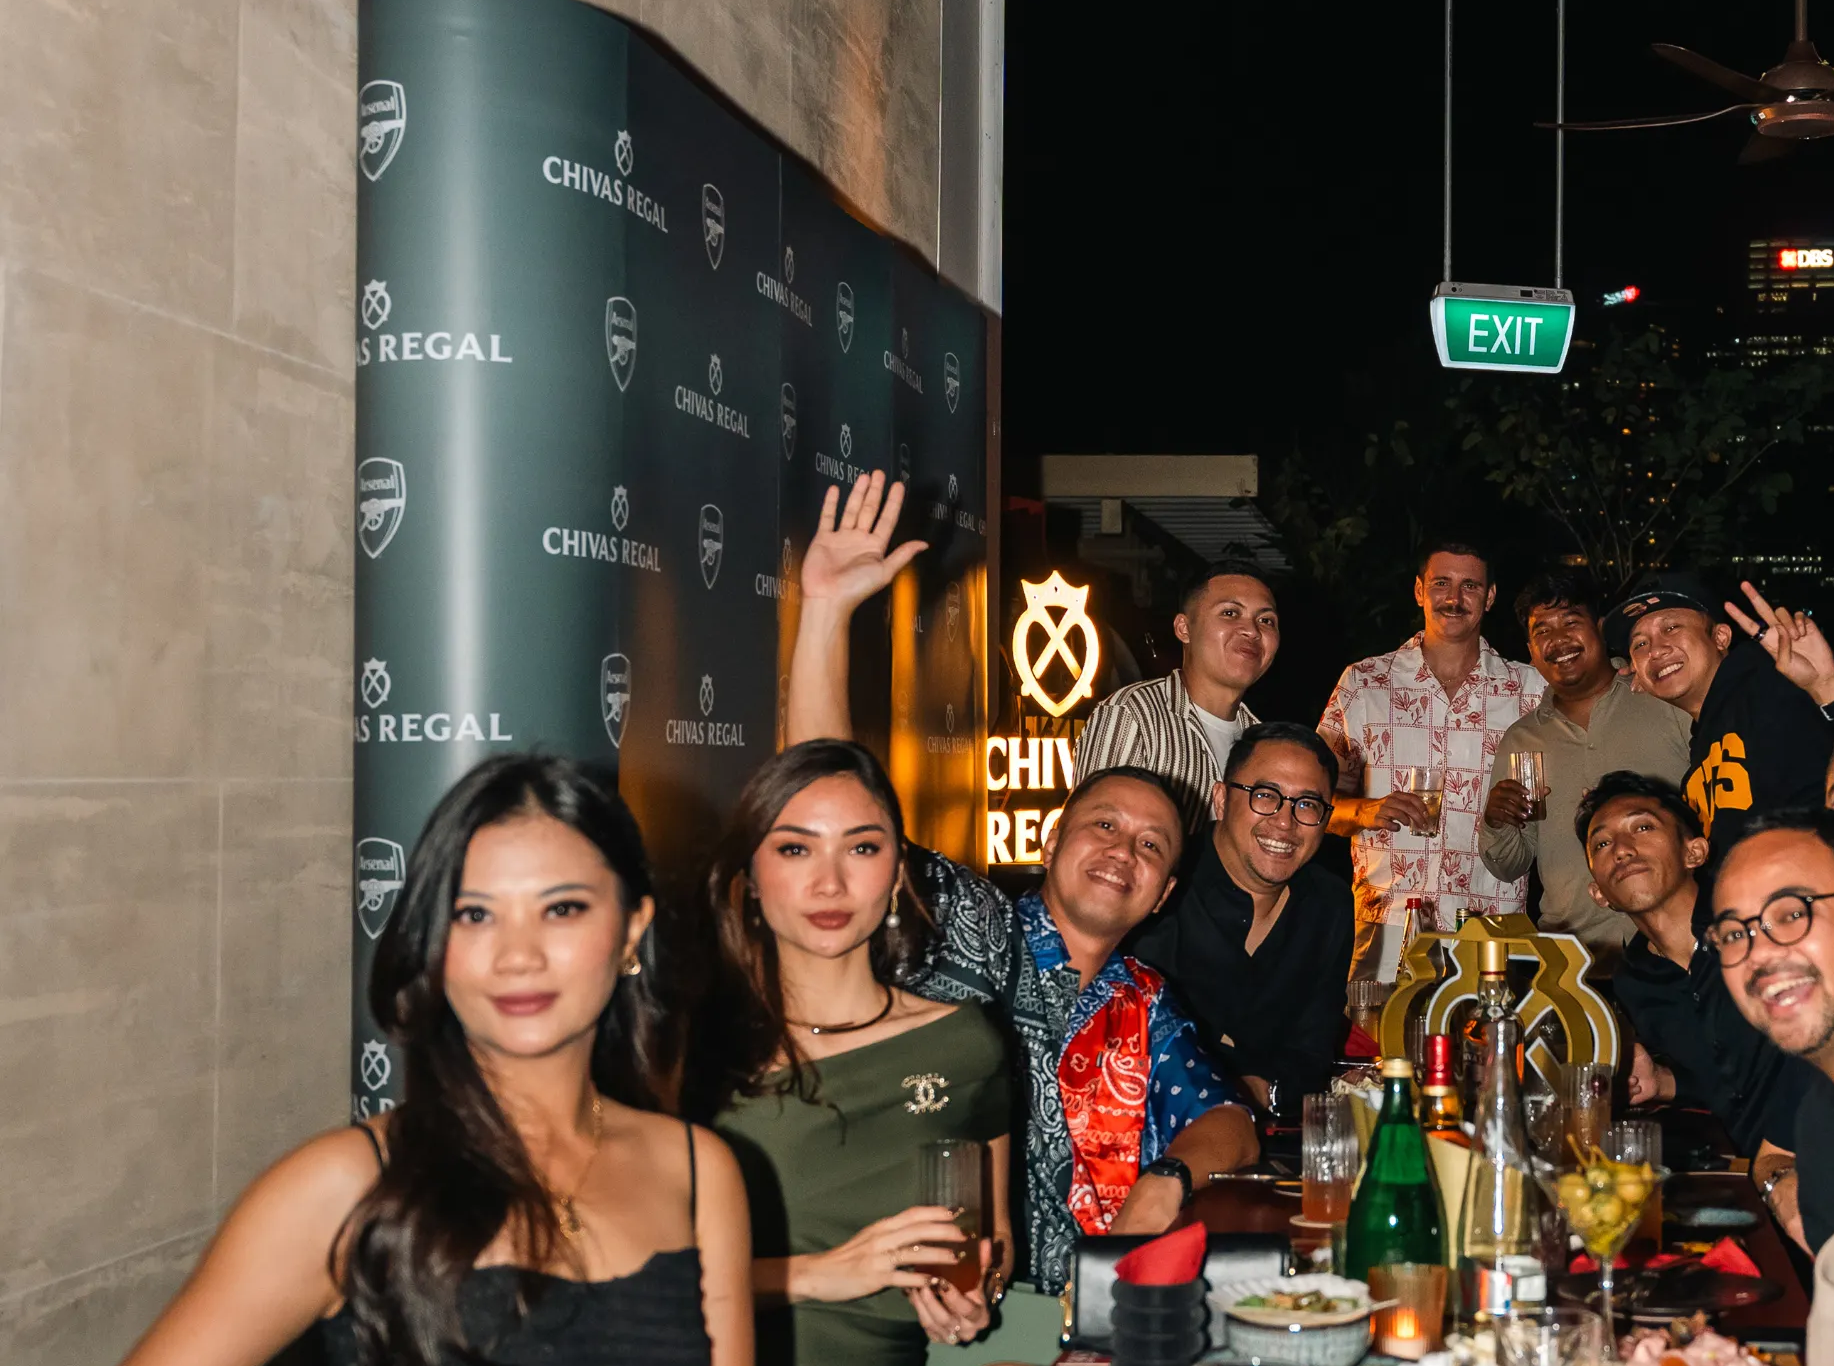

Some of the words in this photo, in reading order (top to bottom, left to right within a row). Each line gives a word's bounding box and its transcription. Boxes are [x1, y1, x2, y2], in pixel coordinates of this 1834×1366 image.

[543, 156, 622, 206] CHIVAS
[627, 185, 668, 233] REGAL
[1797, 249, 1833, 268] DBS
[756, 271, 790, 313] CHIVAS
[790, 290, 812, 327] REGAL
[378, 331, 513, 363] REGAL
[1468, 313, 1543, 356] EXIT
[675, 385, 714, 423] CHIVAS
[717, 402, 750, 438] REGAL
[815, 452, 845, 482] CHIVAS
[542, 526, 617, 563] CHIVAS
[621, 538, 661, 572] REGAL
[379, 713, 513, 742] REGAL
[666, 719, 705, 746] CHIVAS
[707, 722, 745, 747] REGAL
